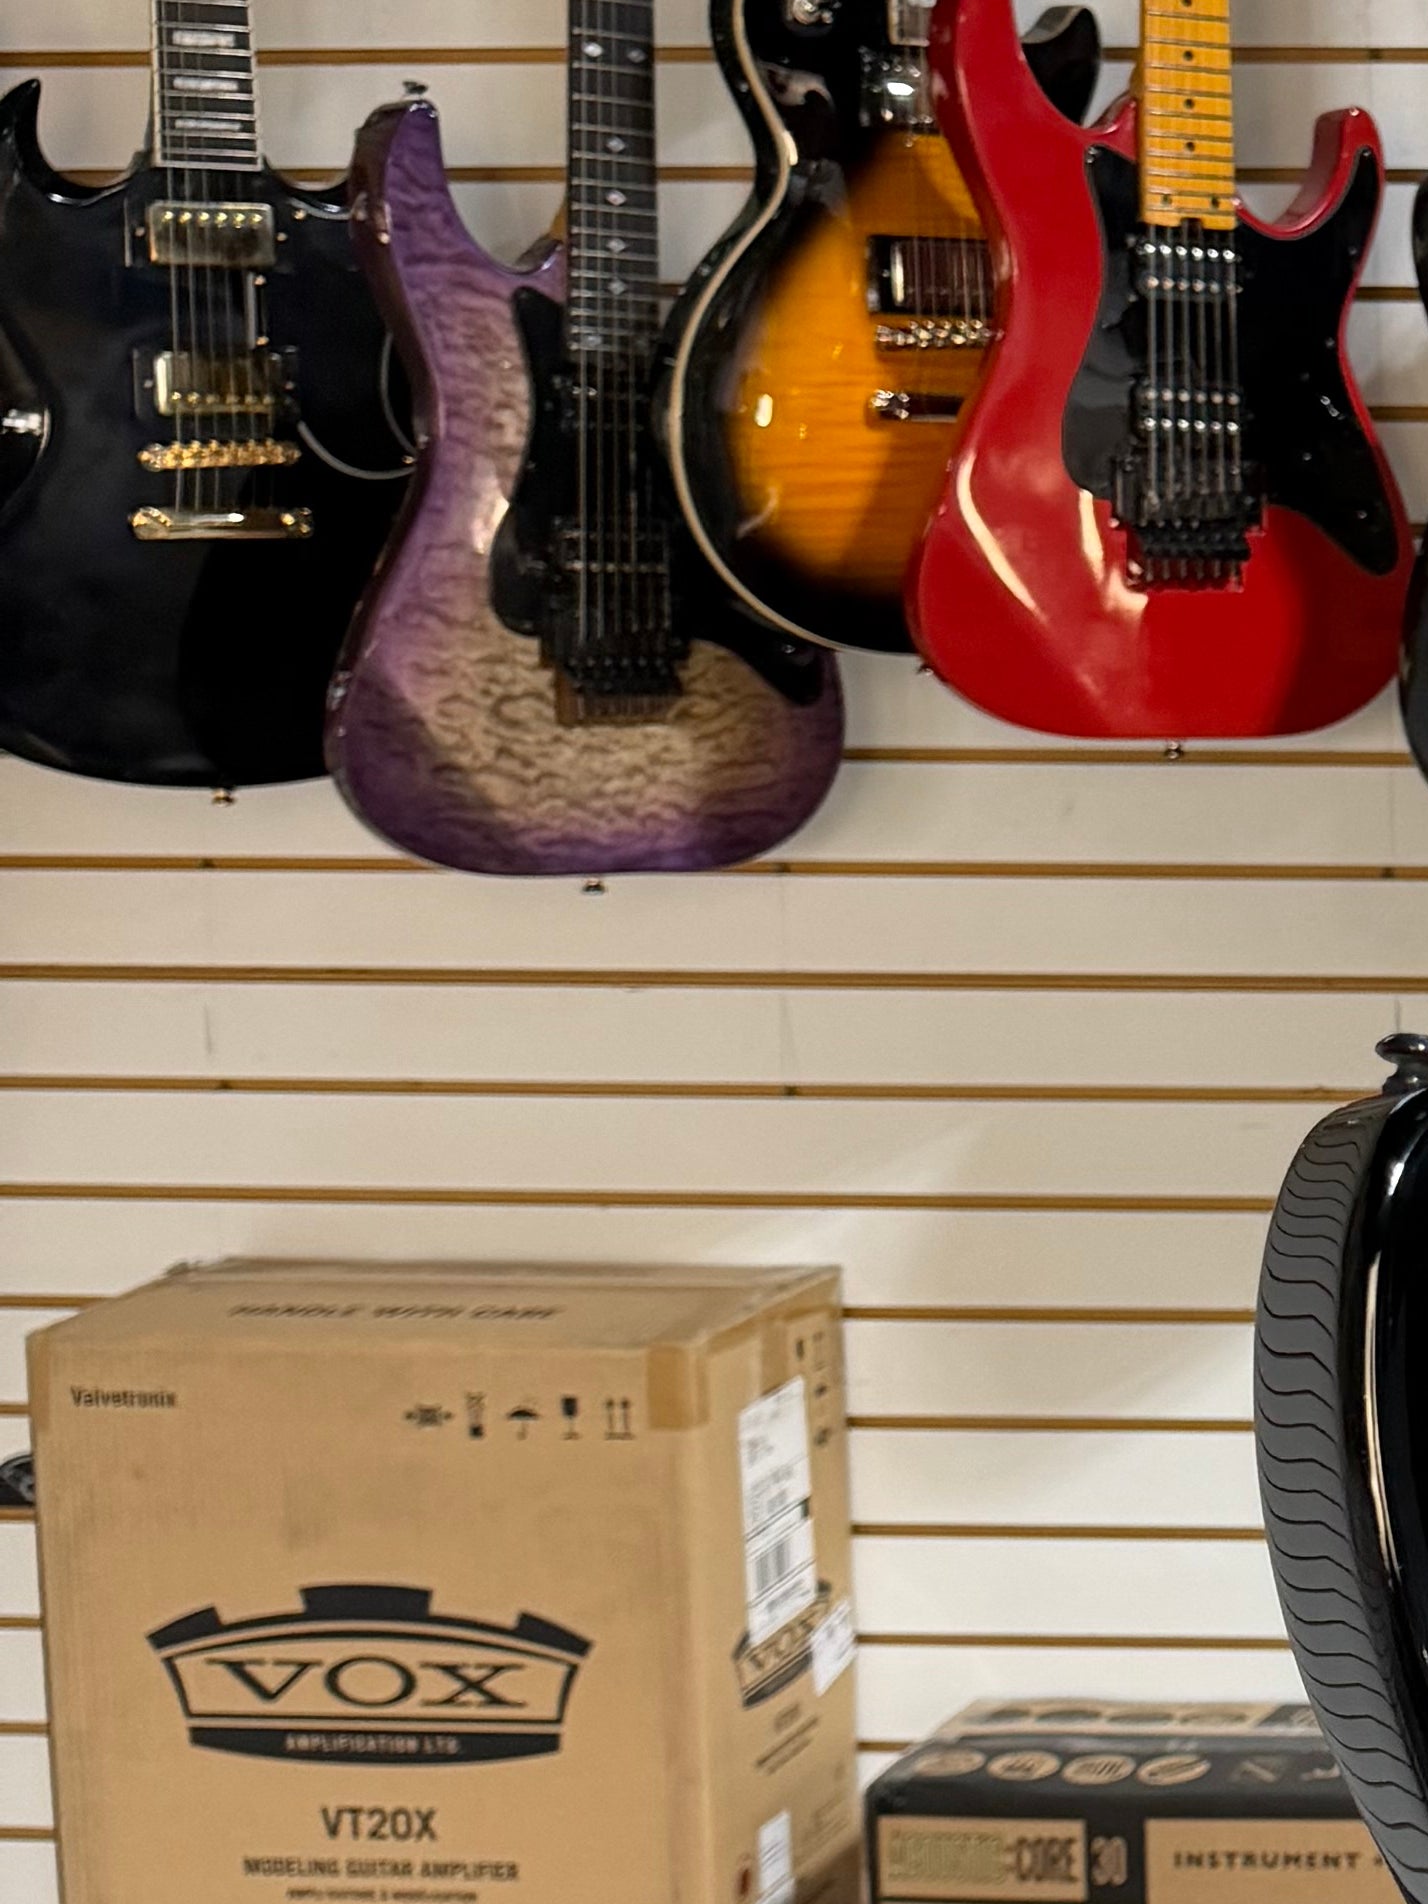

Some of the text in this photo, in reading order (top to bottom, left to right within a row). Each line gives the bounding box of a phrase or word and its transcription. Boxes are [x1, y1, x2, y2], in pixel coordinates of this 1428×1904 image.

[228, 1302, 564, 1321] HANDLE WITH CARE
[70, 1385, 177, 1409] Valvetronix
[203, 1653, 528, 1709] VOX
[285, 1732, 417, 1755] AMPLIFICATION
[320, 1806, 438, 1842] VT20X
[243, 1857, 521, 1881] MODELING GUITAR AMPLIFIER
[1173, 1849, 1364, 1873] INSTRUMENT
